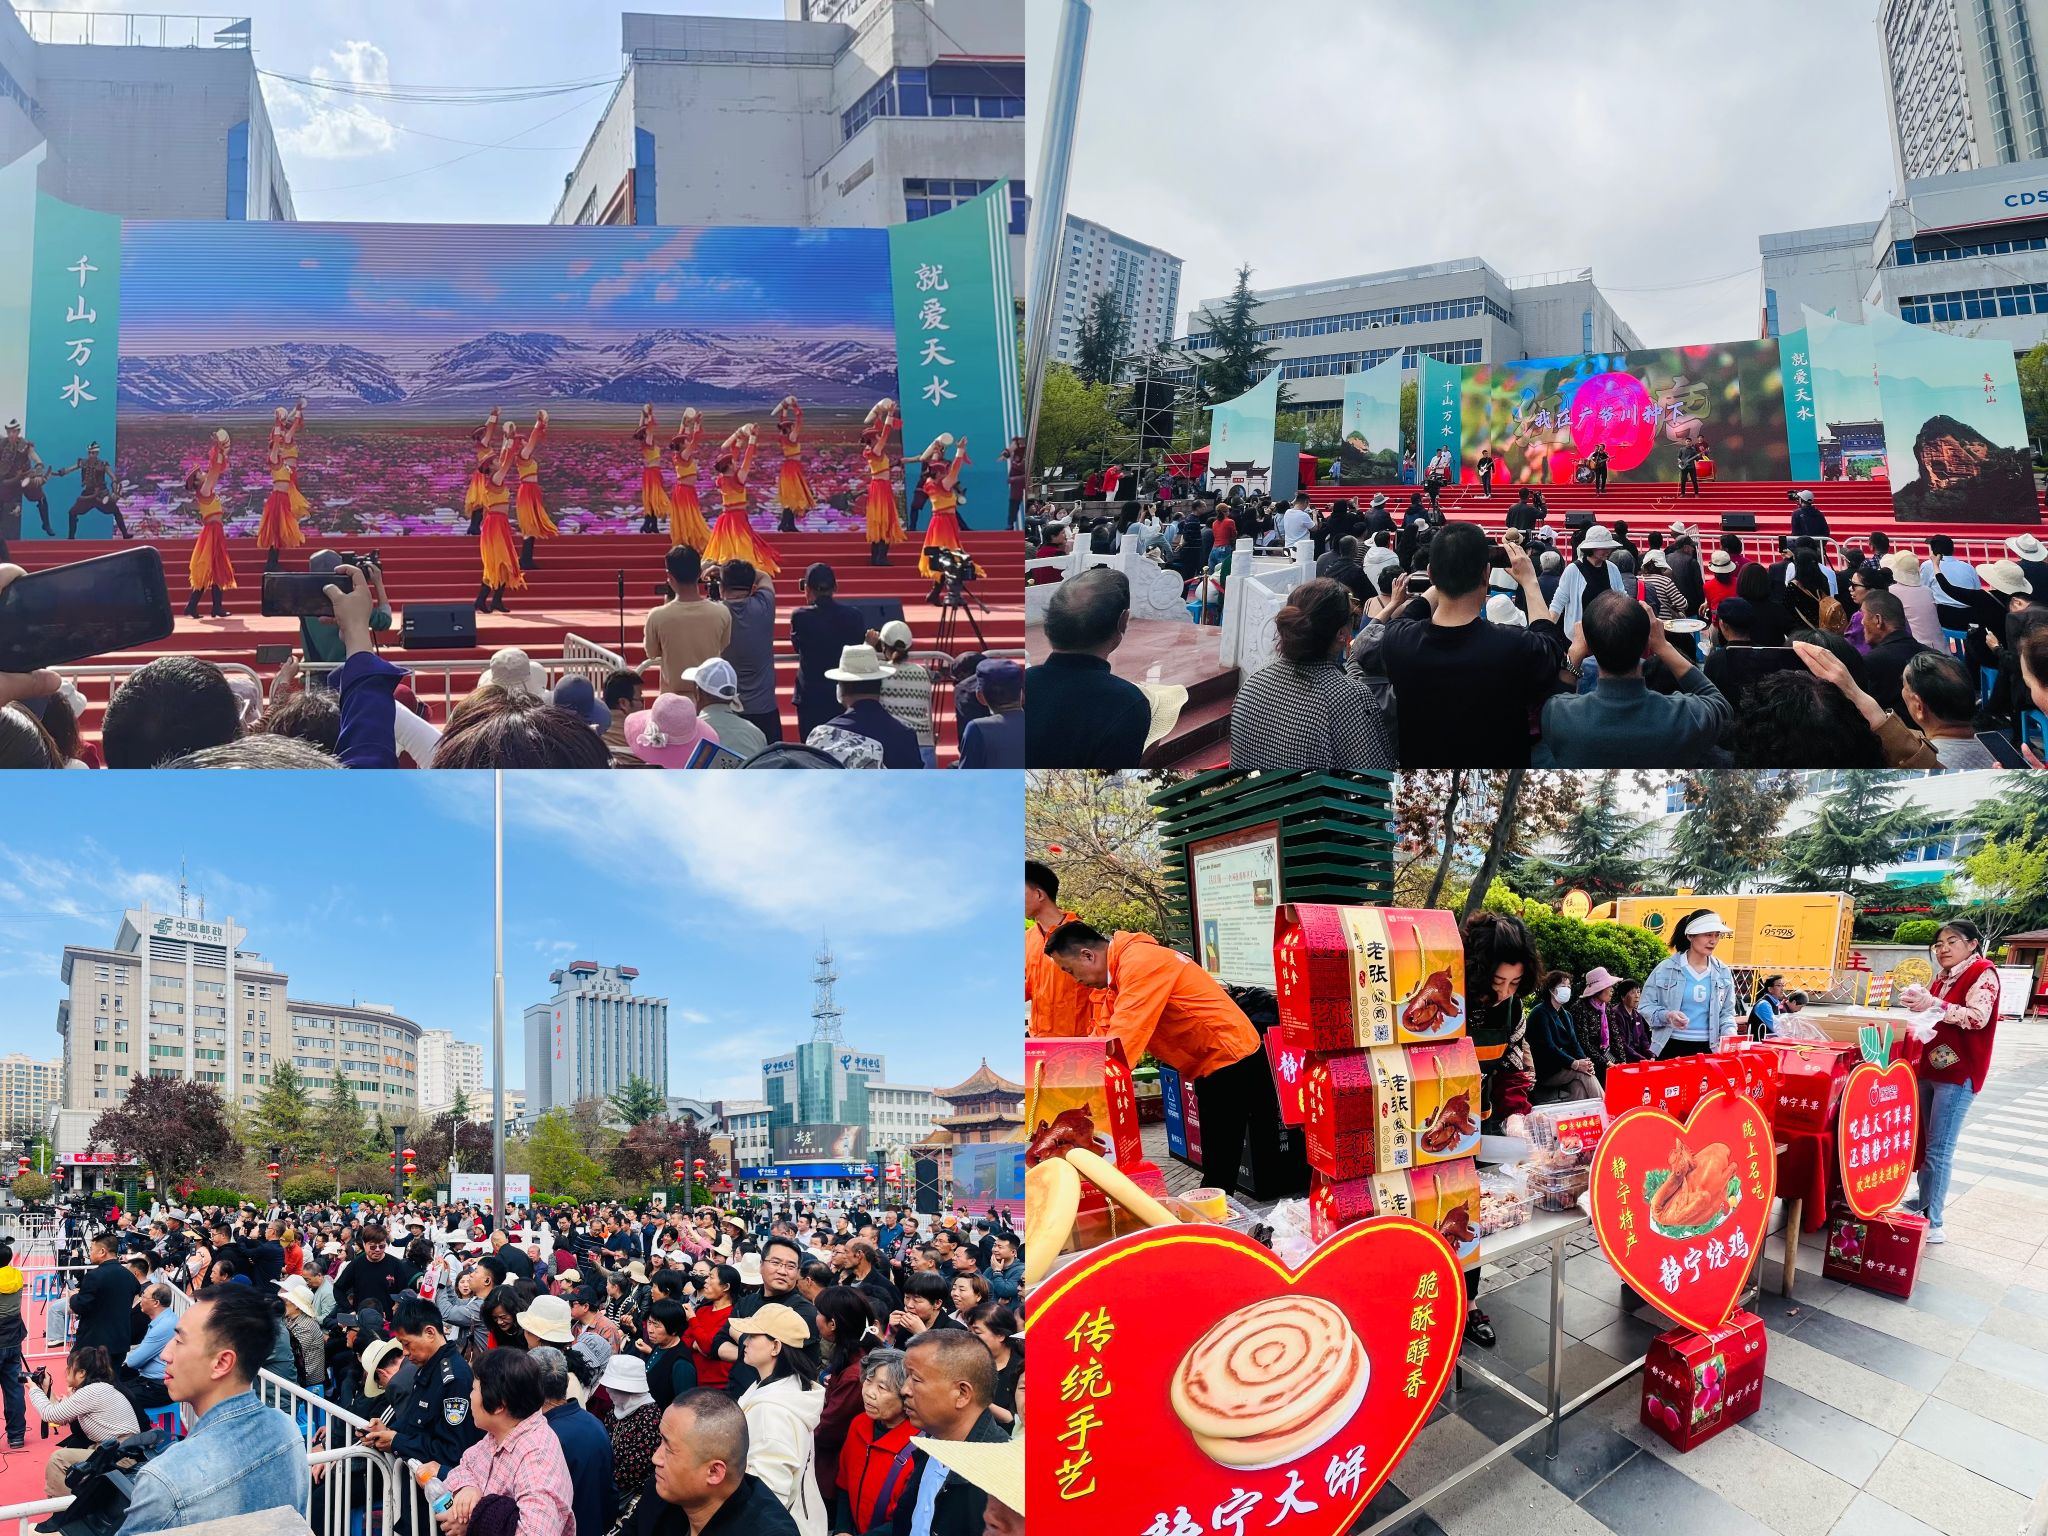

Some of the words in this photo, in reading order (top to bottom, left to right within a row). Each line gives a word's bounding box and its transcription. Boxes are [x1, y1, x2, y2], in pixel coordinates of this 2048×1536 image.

[60, 255, 98, 408] 千山万水
[914, 263, 958, 407] 就爱天水
[1791, 352, 1815, 421] 就爱天水
[1982, 371, 1997, 404] 麦积山
[1440, 380, 1455, 437] 千山万水
[175, 930, 199, 940] CHINA
[202, 935, 222, 943] POST
[176, 921, 222, 936] 中国邮政
[1764, 928, 1793, 938] 95598
[1694, 985, 1707, 1003] G
[773, 1060, 795, 1069] 中国电信
[854, 1056, 880, 1068] 中国电信
[1278, 1050, 1305, 1084] 静
[1779, 1095, 1819, 1110] 静宁苹果
[1849, 1104, 1912, 1140] 吃遍天下苹果
[1742, 1119, 1765, 1200] 陇上名吃
[1849, 1129, 1912, 1168] 还想静宁苹果
[1856, 1160, 1906, 1192] 欢迎您走进静宁
[1392, 1193, 1408, 1216] 老
[1611, 1156, 1638, 1258] 静宁特产
[1658, 1226, 1749, 1294] 静宁烧鸡
[1865, 1259, 1908, 1277] 静宁苹果
[1402, 1270, 1439, 1398] 脆酥醇香
[1651, 1365, 1681, 1389] 静宁苹果
[1726, 1378, 1759, 1407] 静宁苹果
[1055, 1307, 1115, 1500] 传统手艺
